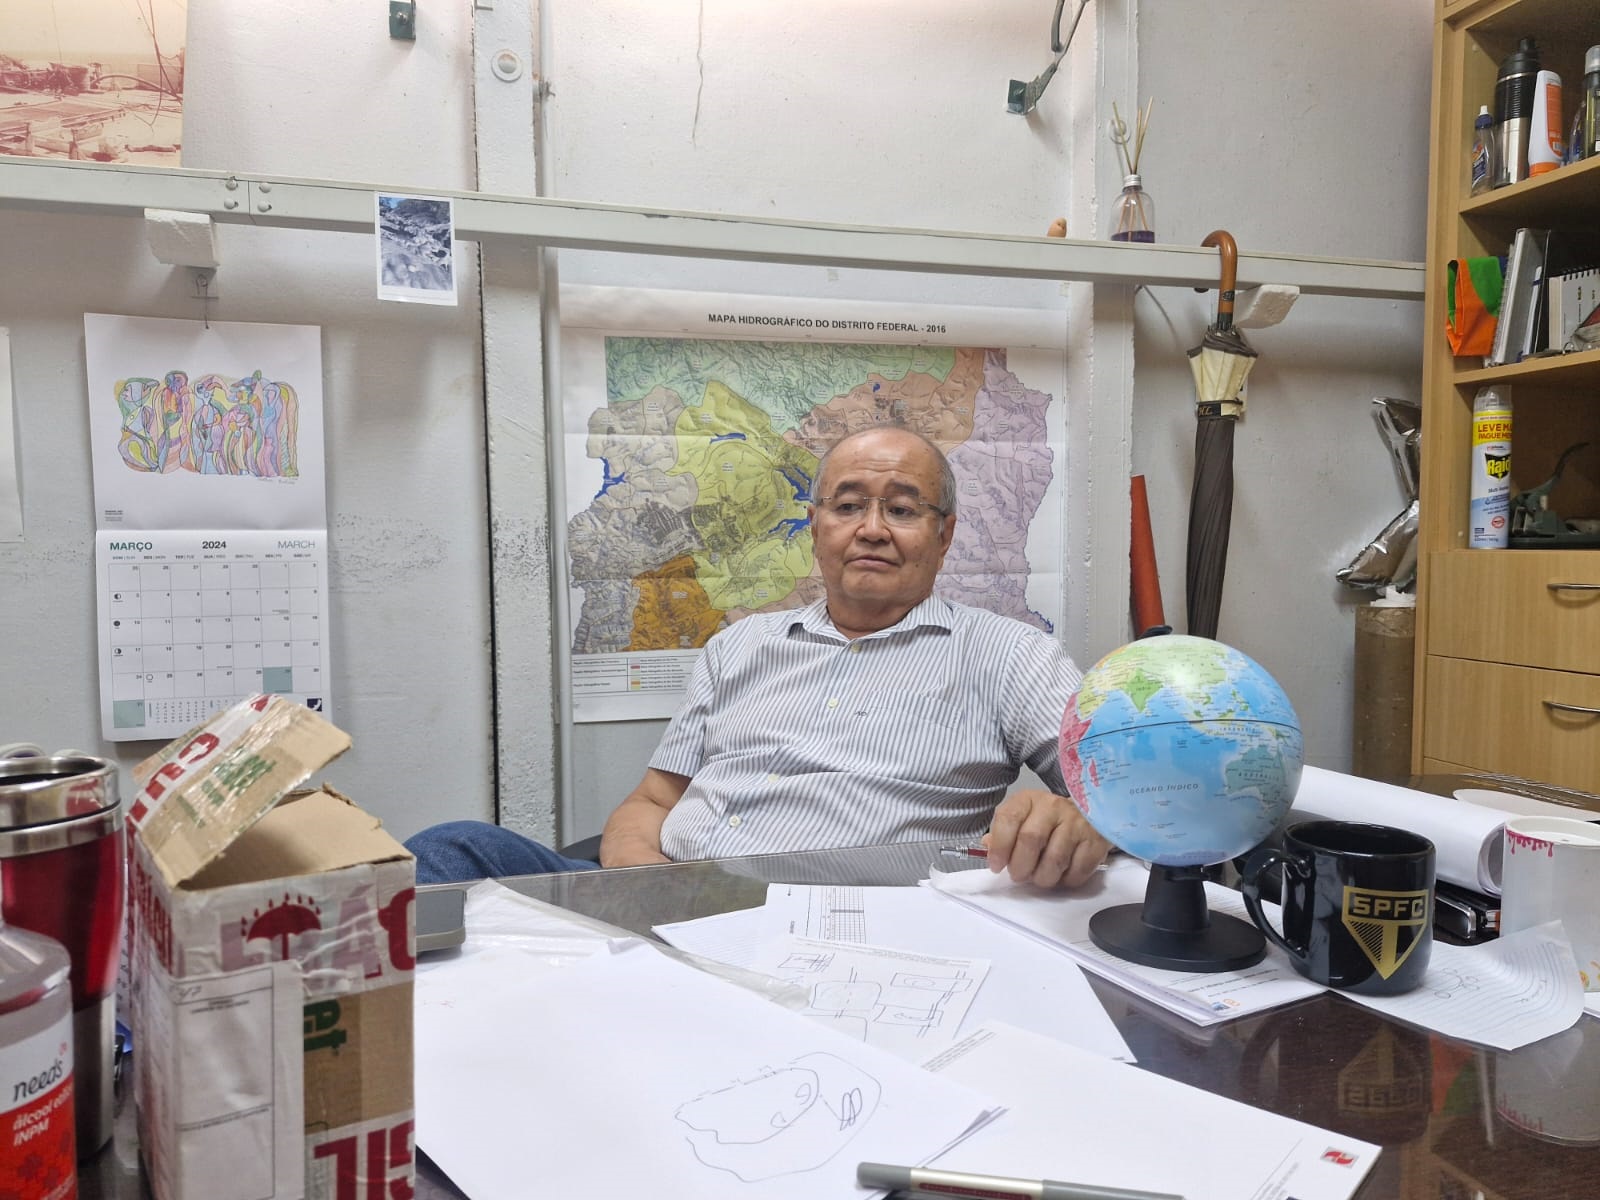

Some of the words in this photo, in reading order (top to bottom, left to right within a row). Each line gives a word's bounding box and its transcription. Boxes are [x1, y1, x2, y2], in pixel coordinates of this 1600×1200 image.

[708, 313, 737, 324] MAPA
[738, 315, 813, 328] HIDROGRÁFICO
[815, 319, 830, 328] DO
[832, 320, 875, 331] DISTRITO
[877, 322, 919, 332] FEDERAL
[926, 324, 946, 334] 2016
[1478, 423, 1502, 433] LEVE
[109, 541, 153, 552] MARÇO
[202, 540, 226, 550] 2024
[278, 540, 316, 550] MARCH
[1129, 785, 1164, 796] OCEANO
[1352, 896, 1425, 918] SPFC
[13, 1058, 64, 1103] needs
